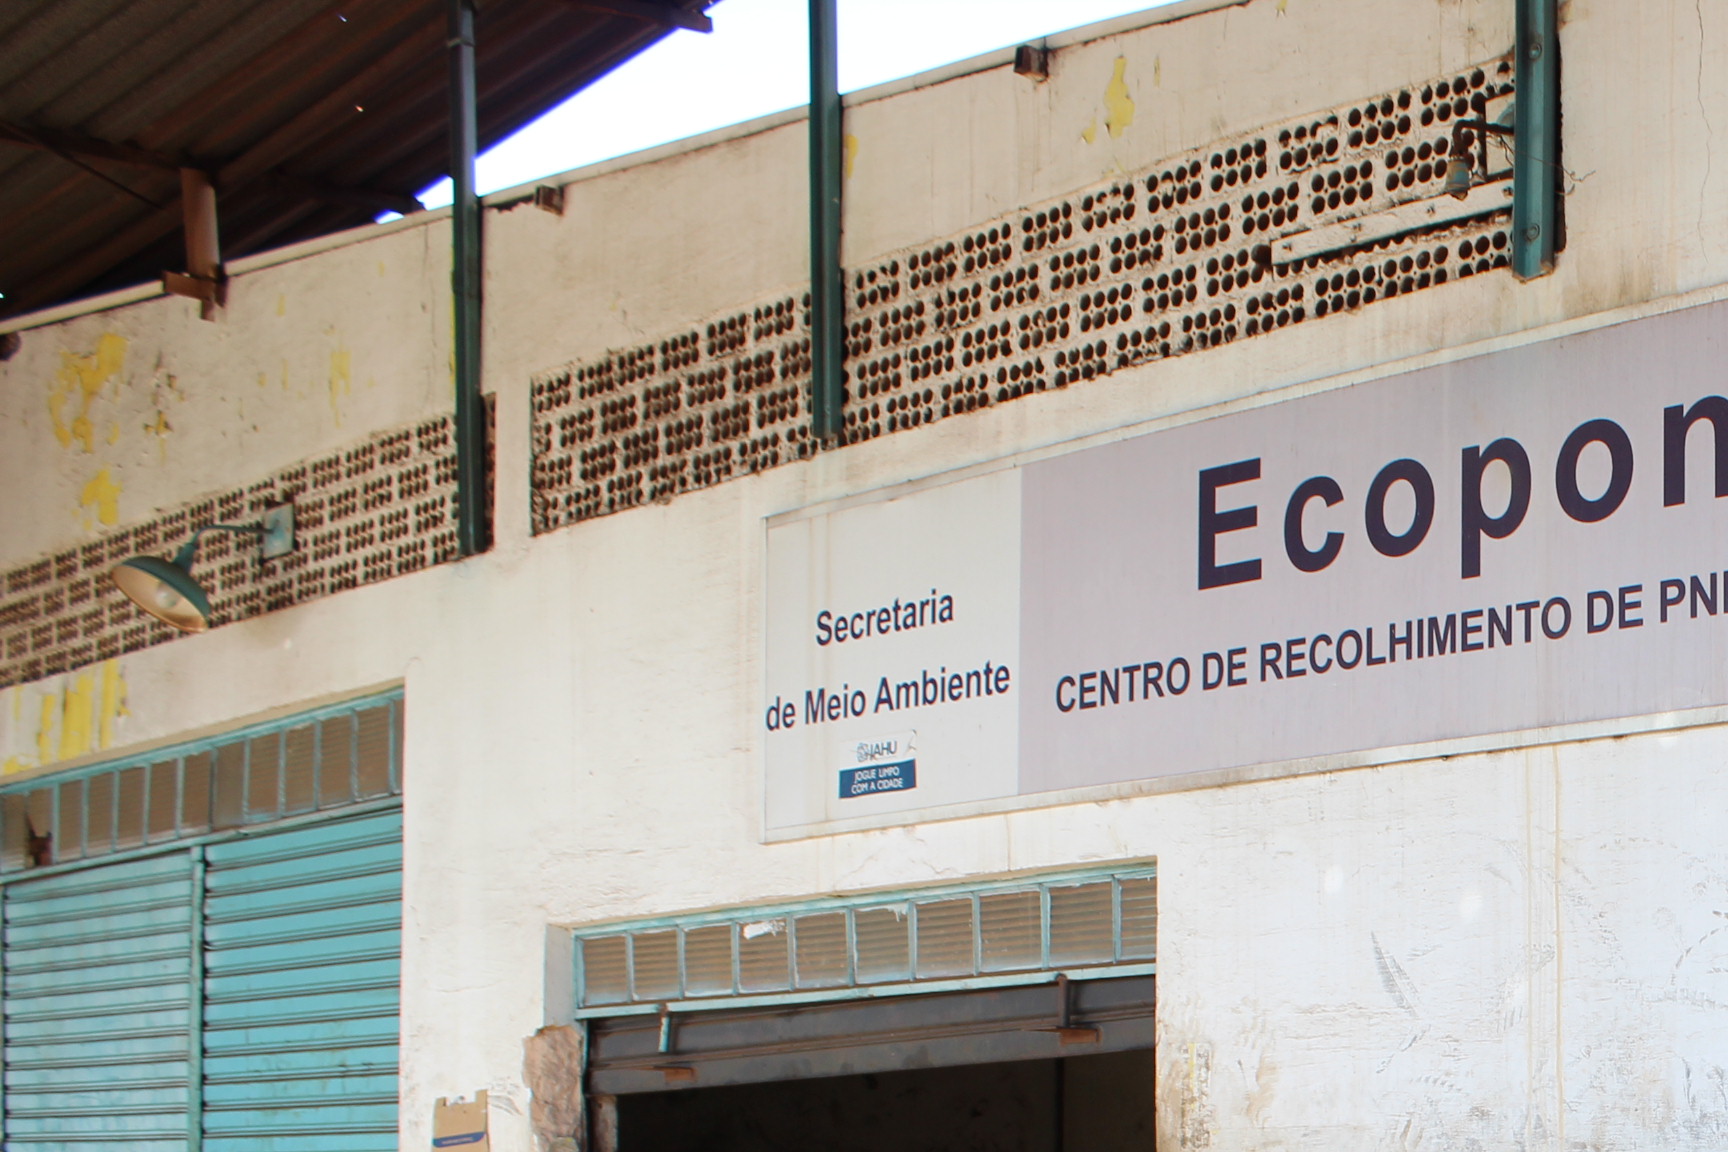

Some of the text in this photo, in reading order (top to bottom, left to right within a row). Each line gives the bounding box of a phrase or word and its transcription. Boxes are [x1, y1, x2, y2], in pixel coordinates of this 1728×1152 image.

[816, 588, 954, 647] Secretaria
[1056, 657, 1191, 713] CENTRO
[1202, 647, 1248, 691] DE
[1260, 596, 1572, 682] RECOLHIMENTO
[1586, 584, 1644, 634] DE
[766, 660, 1010, 732] de Meio Ambiente
